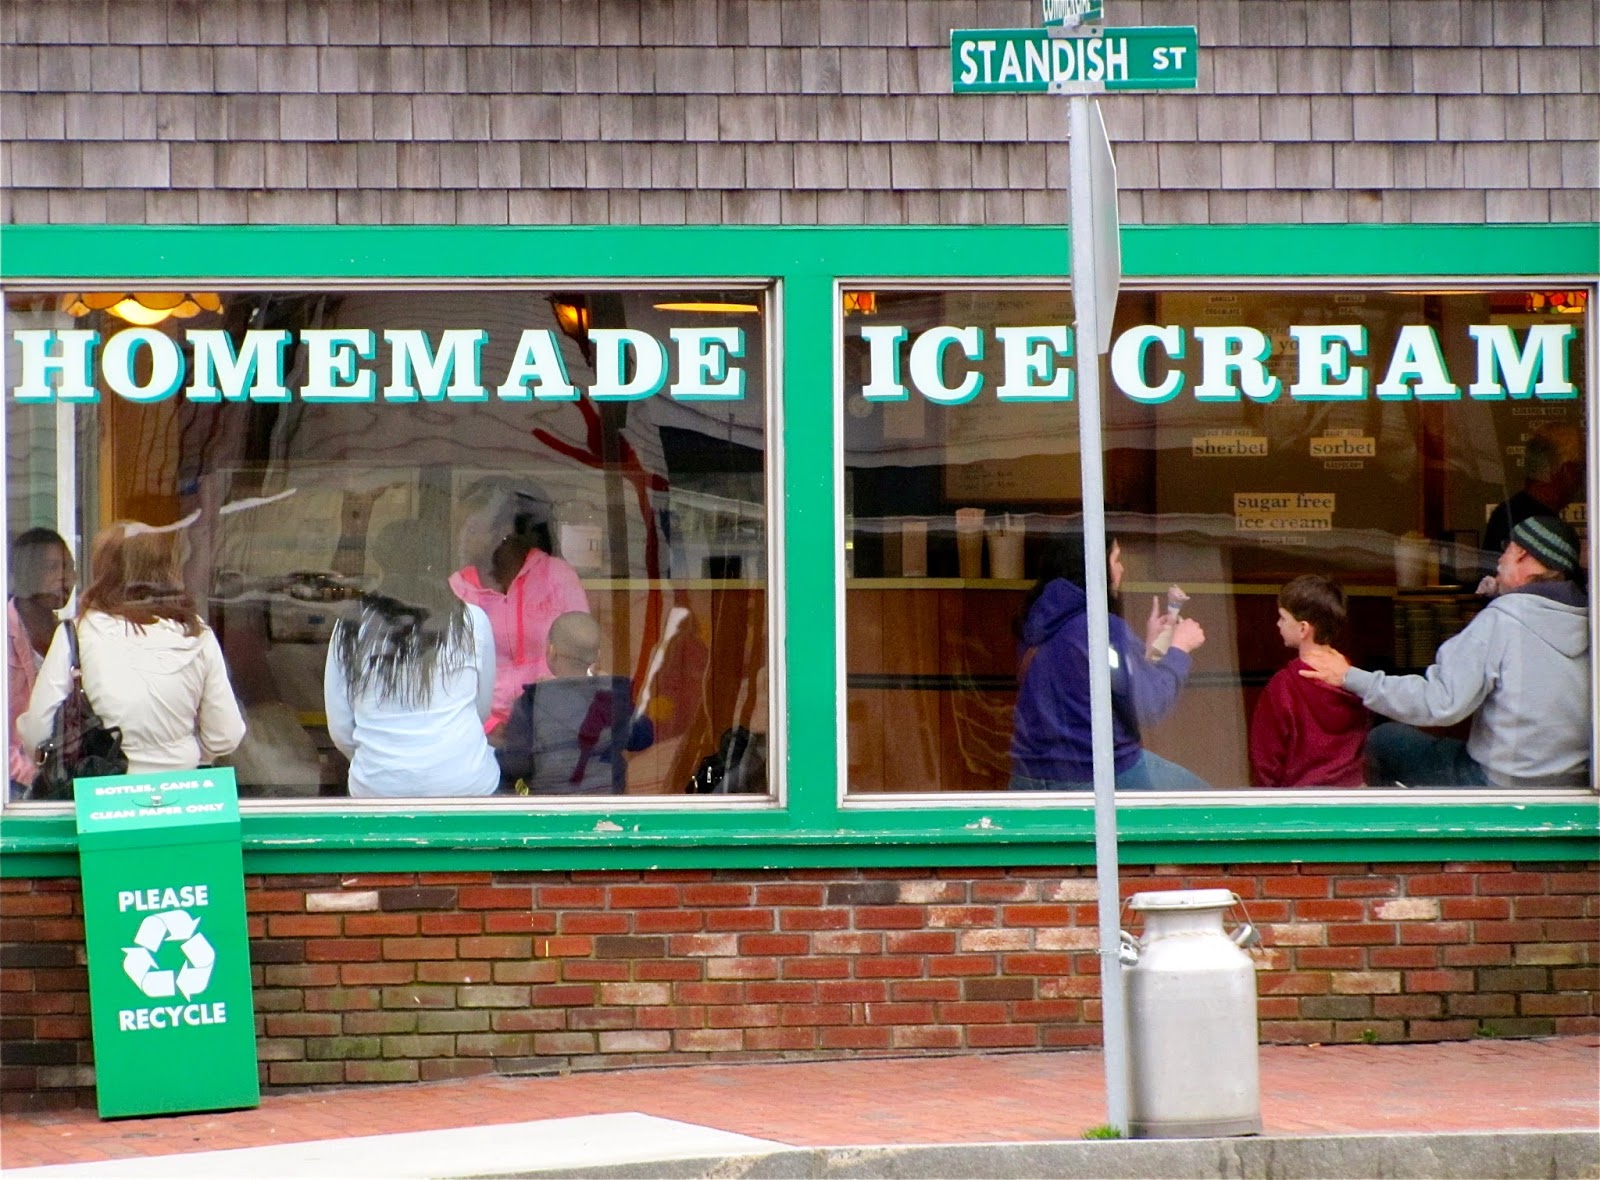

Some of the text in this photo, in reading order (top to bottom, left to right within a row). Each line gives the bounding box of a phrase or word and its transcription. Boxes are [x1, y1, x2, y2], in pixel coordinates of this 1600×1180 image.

[960, 38, 1187, 84] STANDISH ST
[13, 324, 1577, 404] HOMEMADE ICE CREAM
[1194, 439, 1266, 455] sherbet
[1312, 439, 1372, 455] sorbet
[1237, 493, 1333, 512] sugar free
[1238, 513, 1329, 529] ice cream
[94, 779, 215, 796] BOTTLES, CANS &
[89, 802, 225, 820] CLEAN PAPER ONLY
[118, 885, 209, 912] PLEASE
[118, 1002, 226, 1031] RECYCLE
